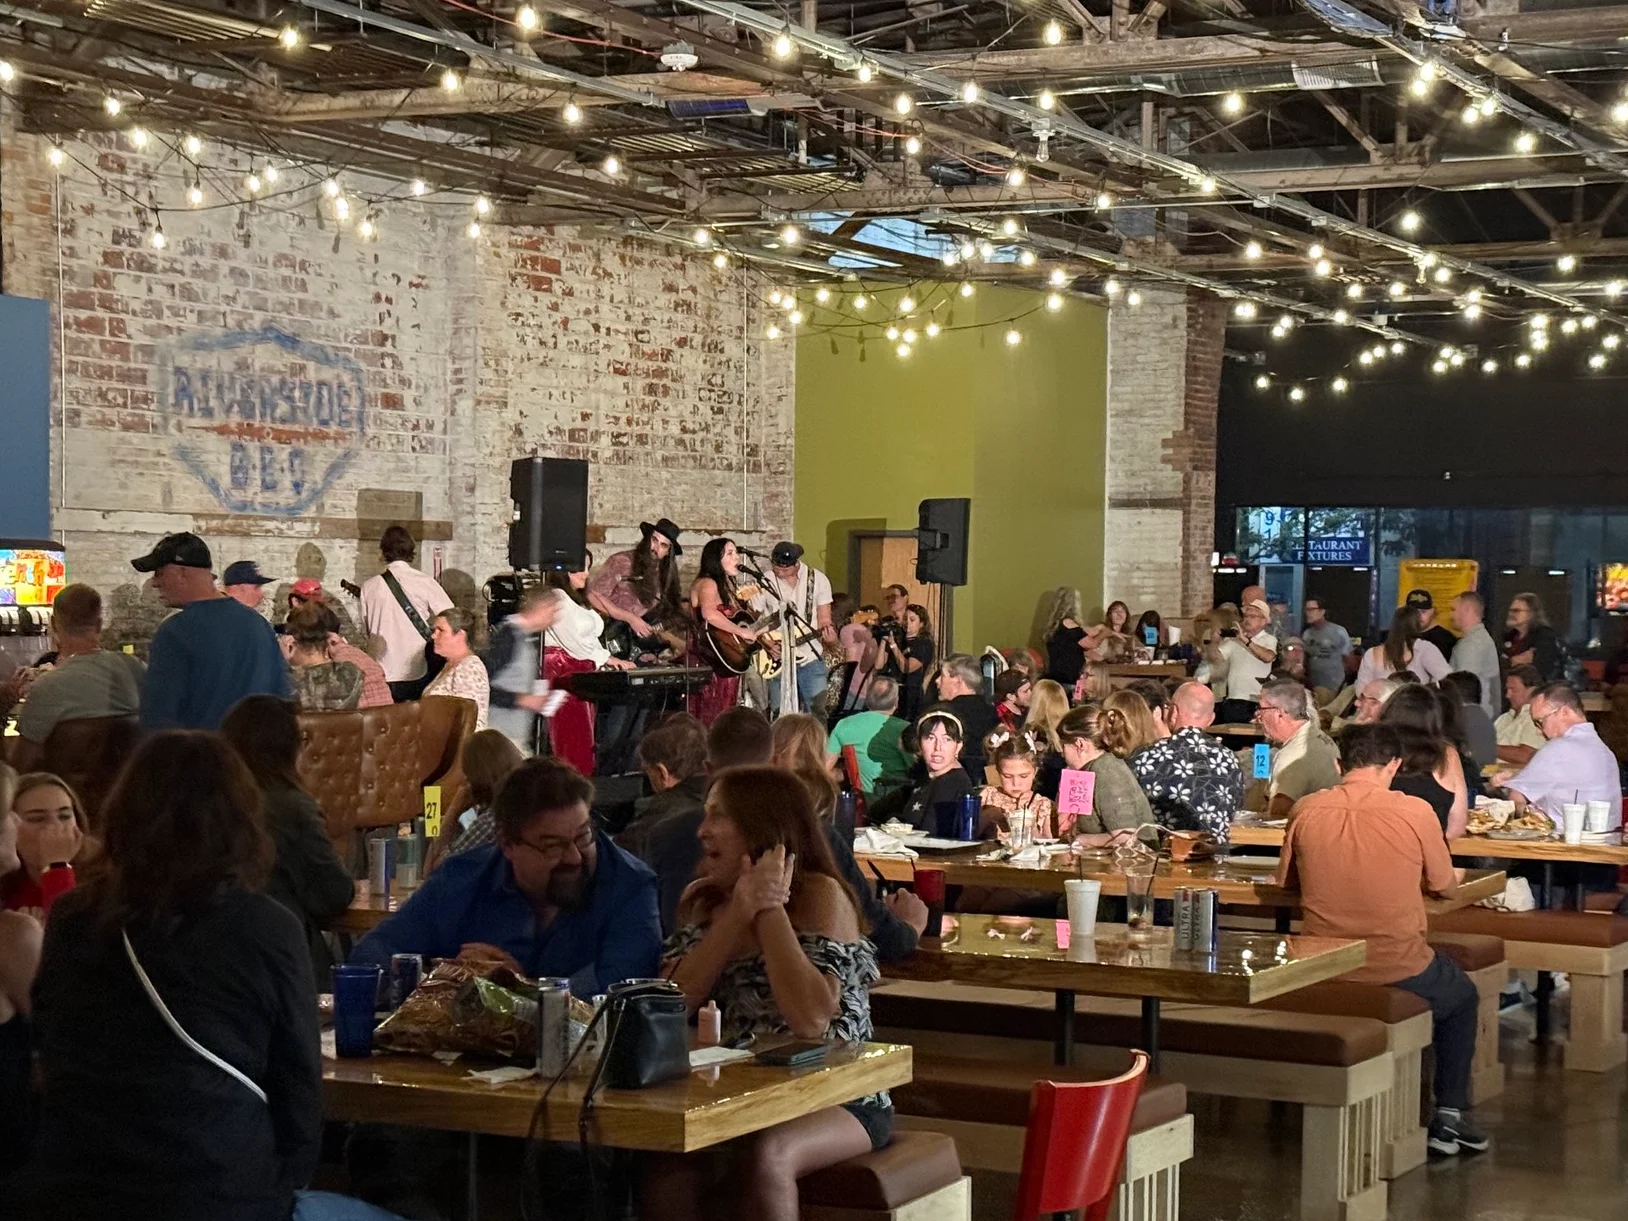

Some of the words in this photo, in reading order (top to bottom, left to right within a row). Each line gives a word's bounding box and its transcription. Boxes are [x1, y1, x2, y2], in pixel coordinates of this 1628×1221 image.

[1297, 551, 1352, 561] FXTURES
[1256, 754, 1266, 767] 12
[426, 802, 437, 819] 27
[1181, 905, 1190, 940] ULTRA
